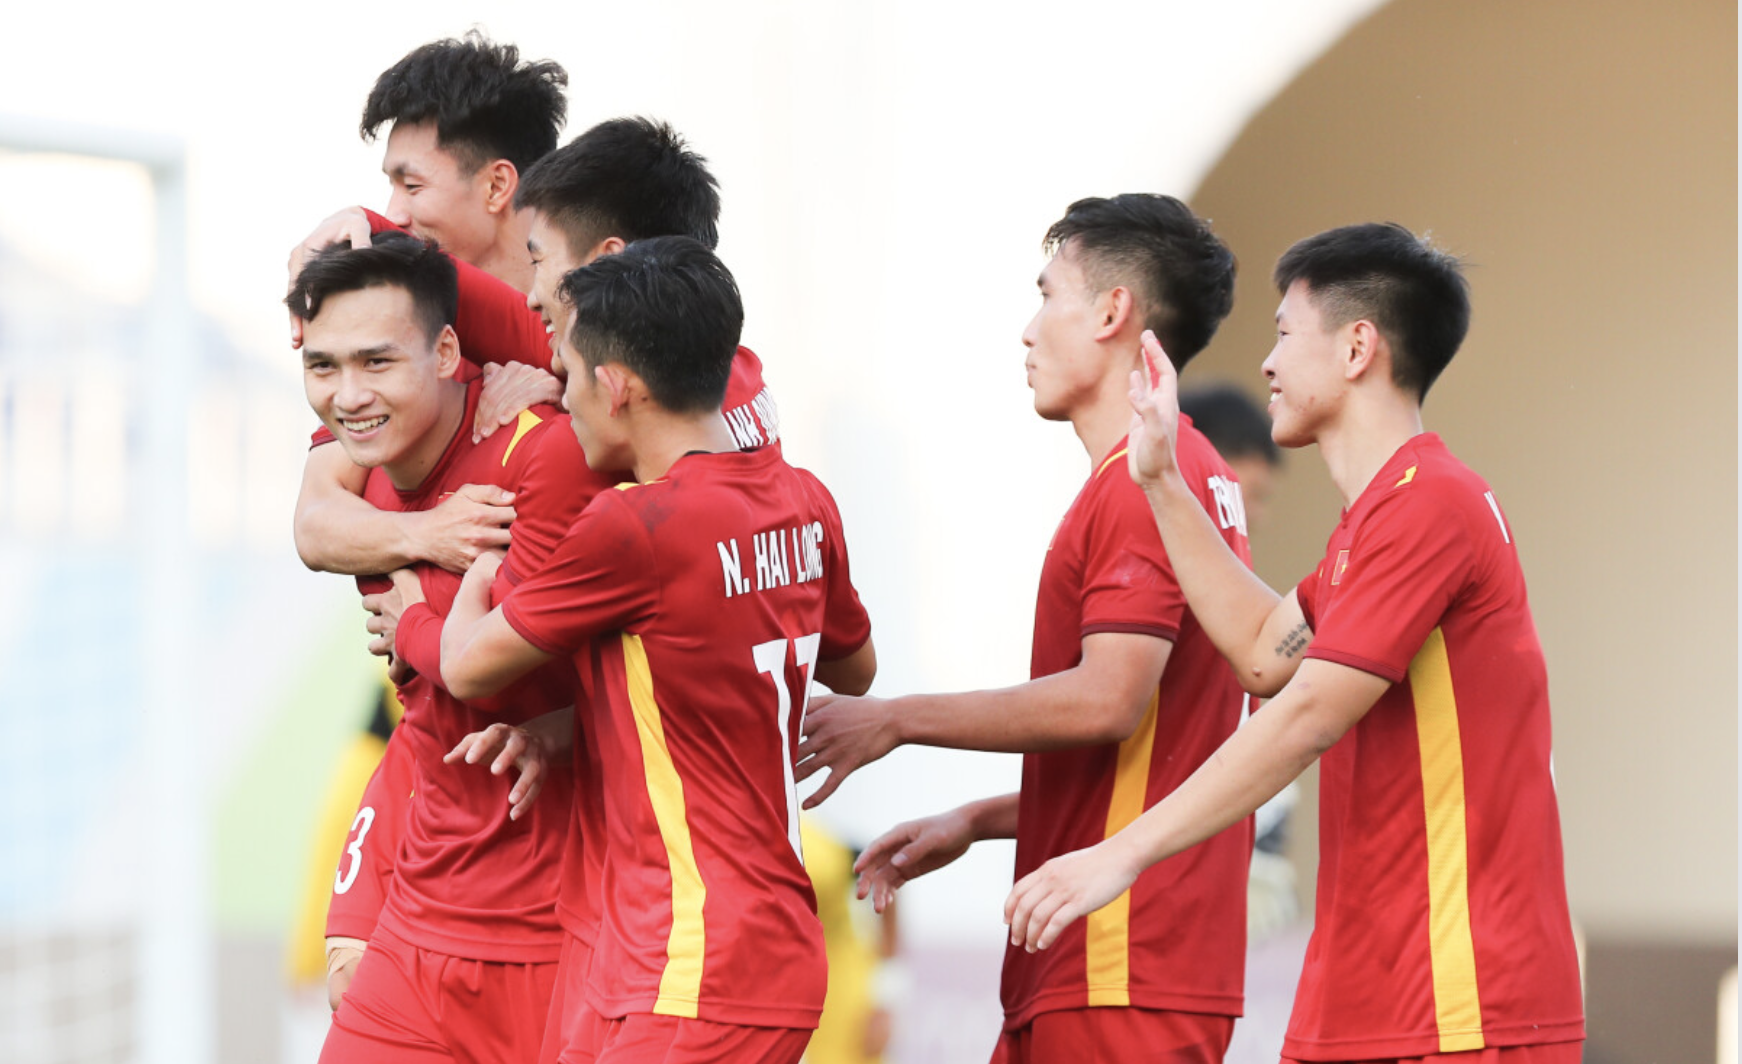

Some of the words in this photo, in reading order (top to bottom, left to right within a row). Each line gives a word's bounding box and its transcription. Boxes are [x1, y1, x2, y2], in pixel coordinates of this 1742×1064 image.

[717, 538, 749, 597] N.
[753, 529, 790, 591] HAI
[792, 521, 823, 582] LONG
[752, 632, 821, 867] 17
